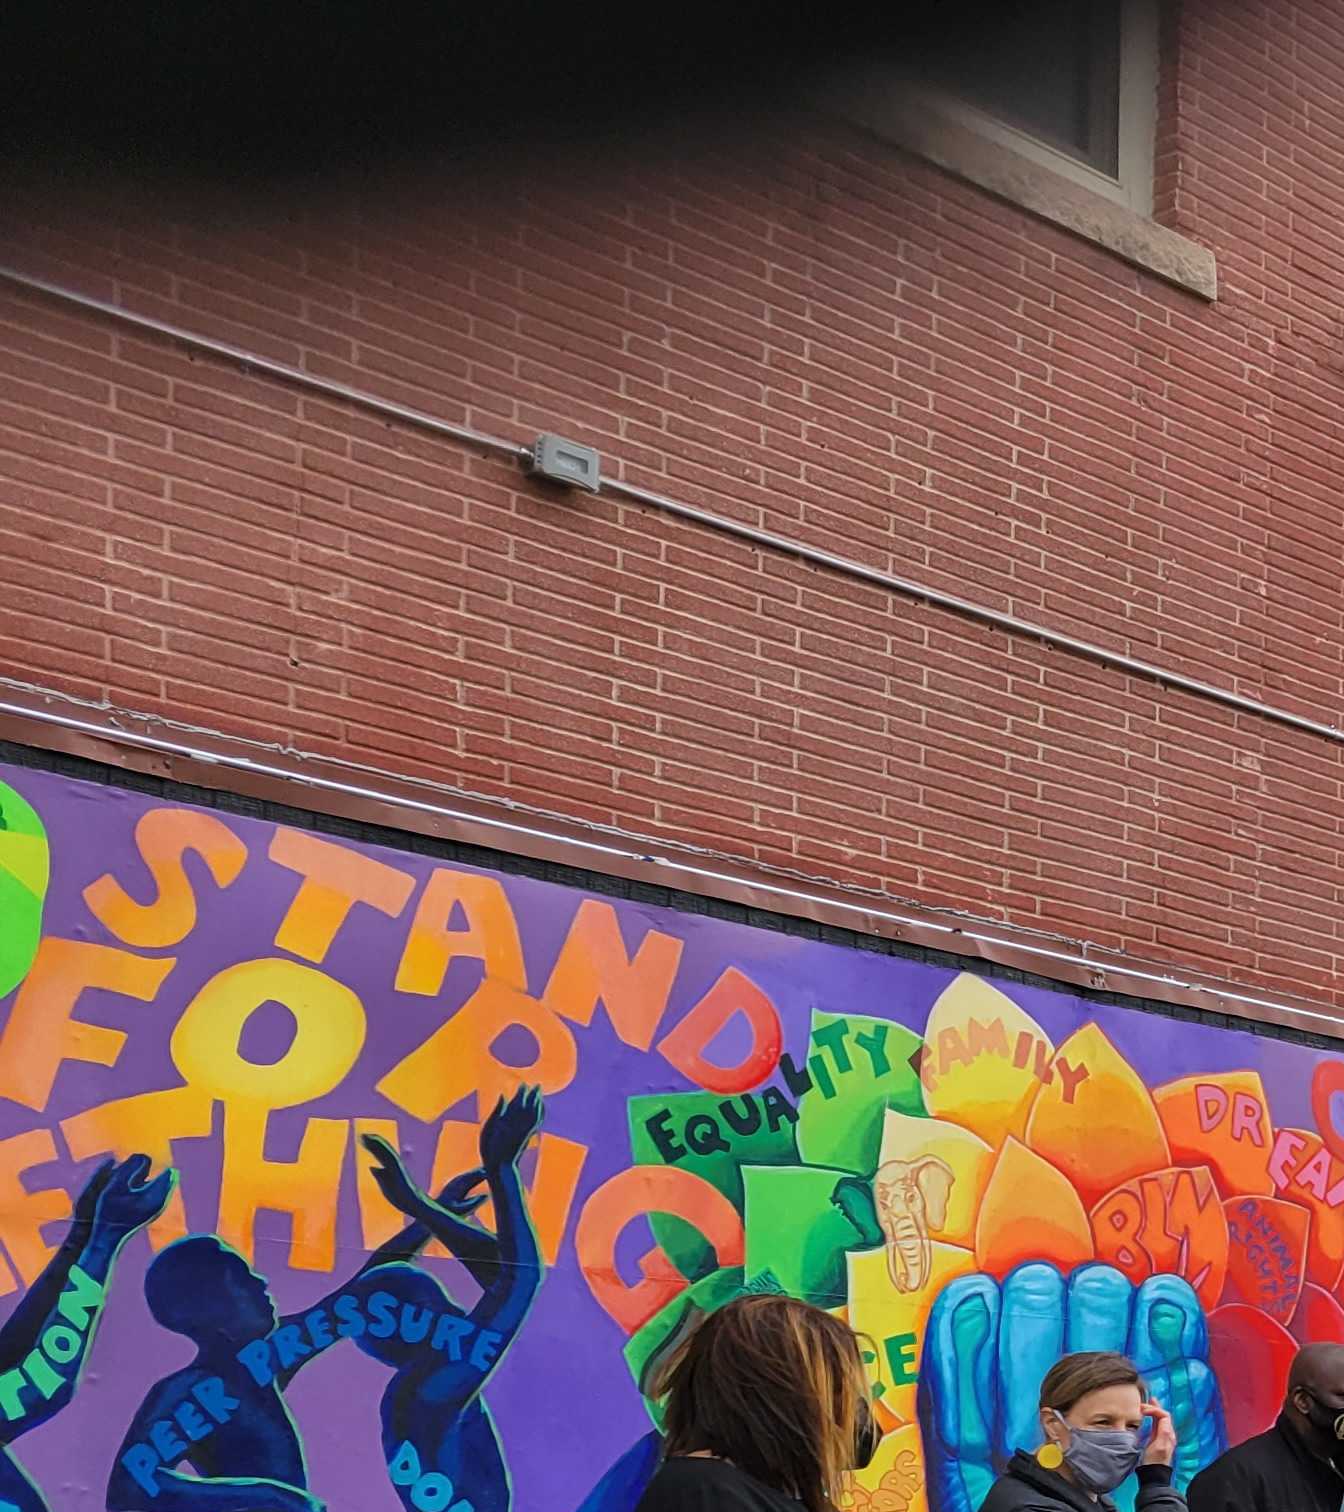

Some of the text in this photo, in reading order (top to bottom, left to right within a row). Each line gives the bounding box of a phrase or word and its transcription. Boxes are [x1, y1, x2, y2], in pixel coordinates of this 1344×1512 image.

[0, 936, 577, 1123] FOR
[83, 808, 783, 1095] STAND
[645, 1018, 891, 1164] EQUALITY
[908, 1018, 1090, 1104] FAMILY
[121, 1293, 504, 1498] PEER PRESSURE
